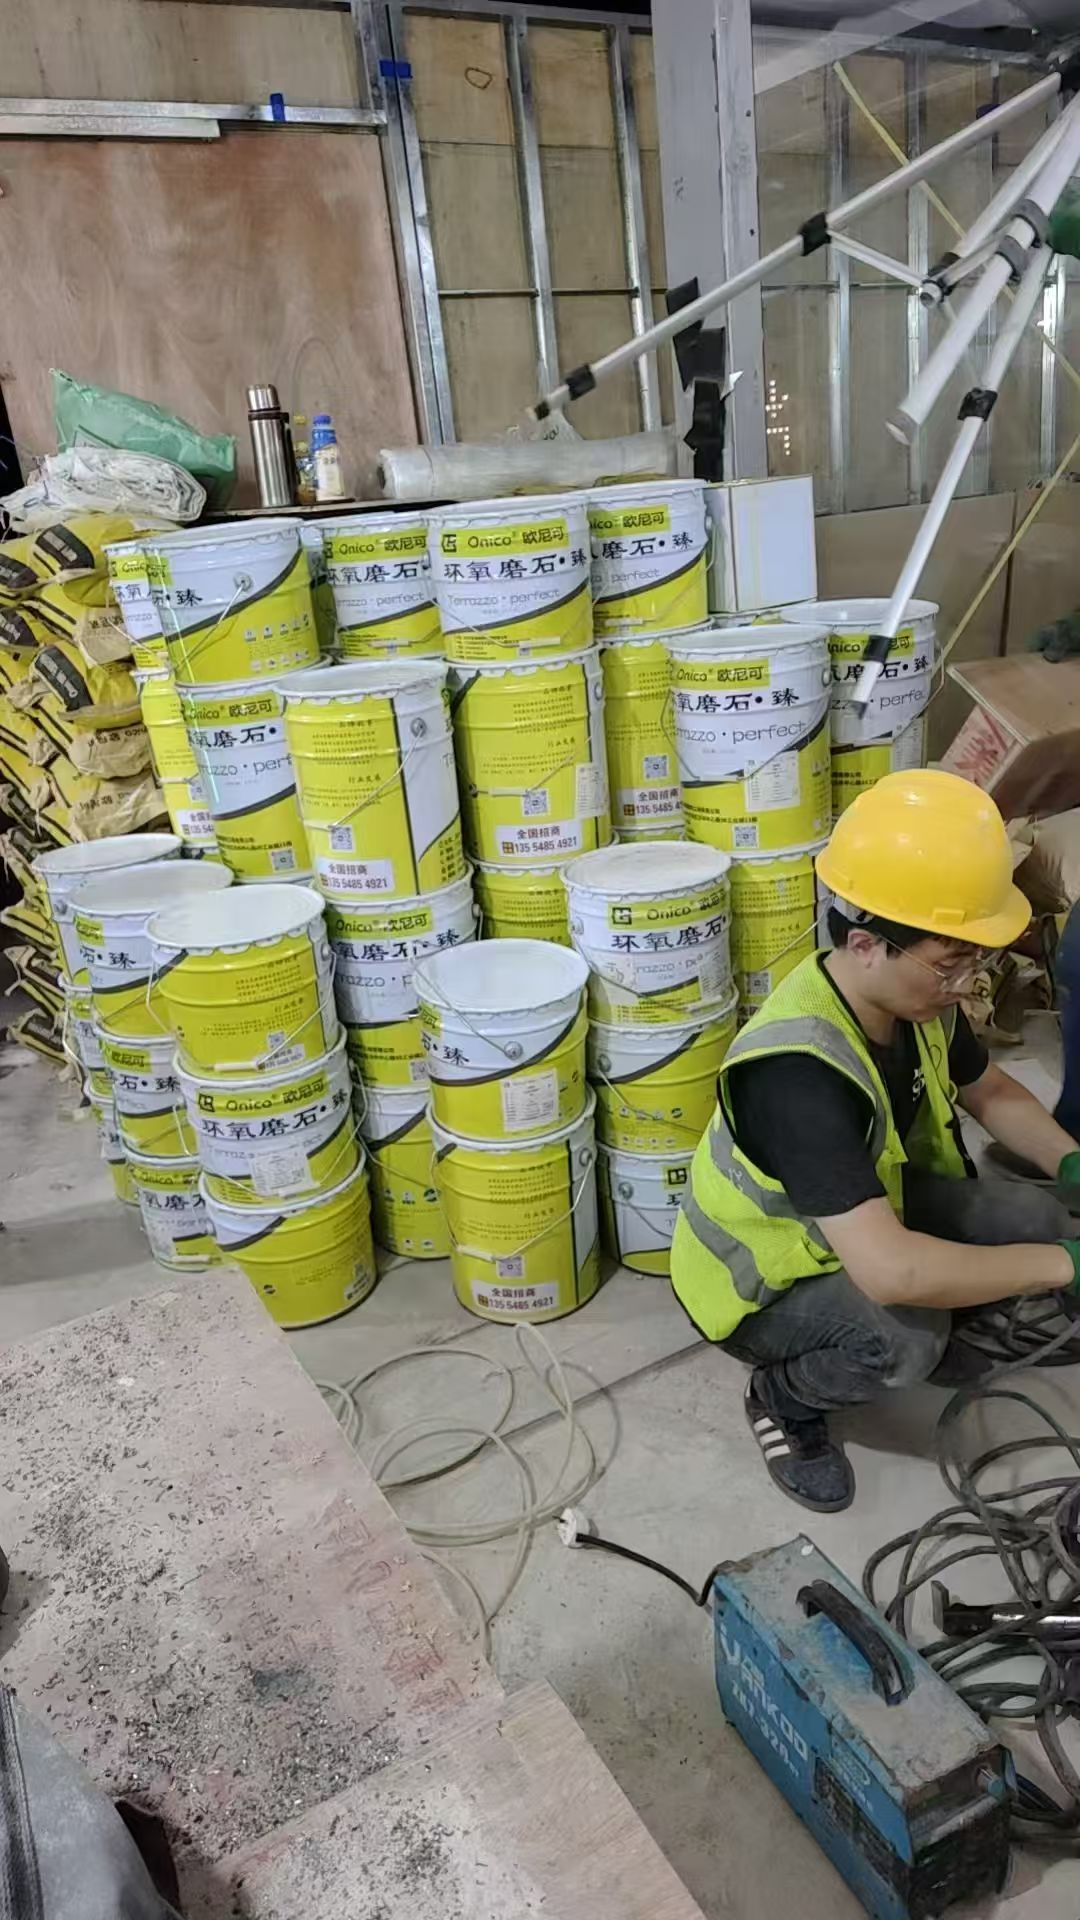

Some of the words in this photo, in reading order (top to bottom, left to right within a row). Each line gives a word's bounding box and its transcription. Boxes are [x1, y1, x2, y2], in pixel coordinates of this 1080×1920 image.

[622, 511, 664, 528] 欧尼可
[468, 535, 512, 549] Onico
[522, 524, 564, 545] 欧尼可
[339, 542, 375, 557] Onico
[384, 536, 427, 552] 欧尼可
[376, 591, 425, 607] perfect
[510, 588, 561, 605] perfect
[716, 665, 763, 682] 欧尼可
[732, 720, 806, 746] perfect
[517, 827, 561, 840] 全国招商
[514, 841, 531, 853] 135
[532, 839, 555, 852] 5485
[557, 836, 577, 849] 4921
[365, 878, 388, 890] 4921
[226, 1097, 273, 1113] Onico
